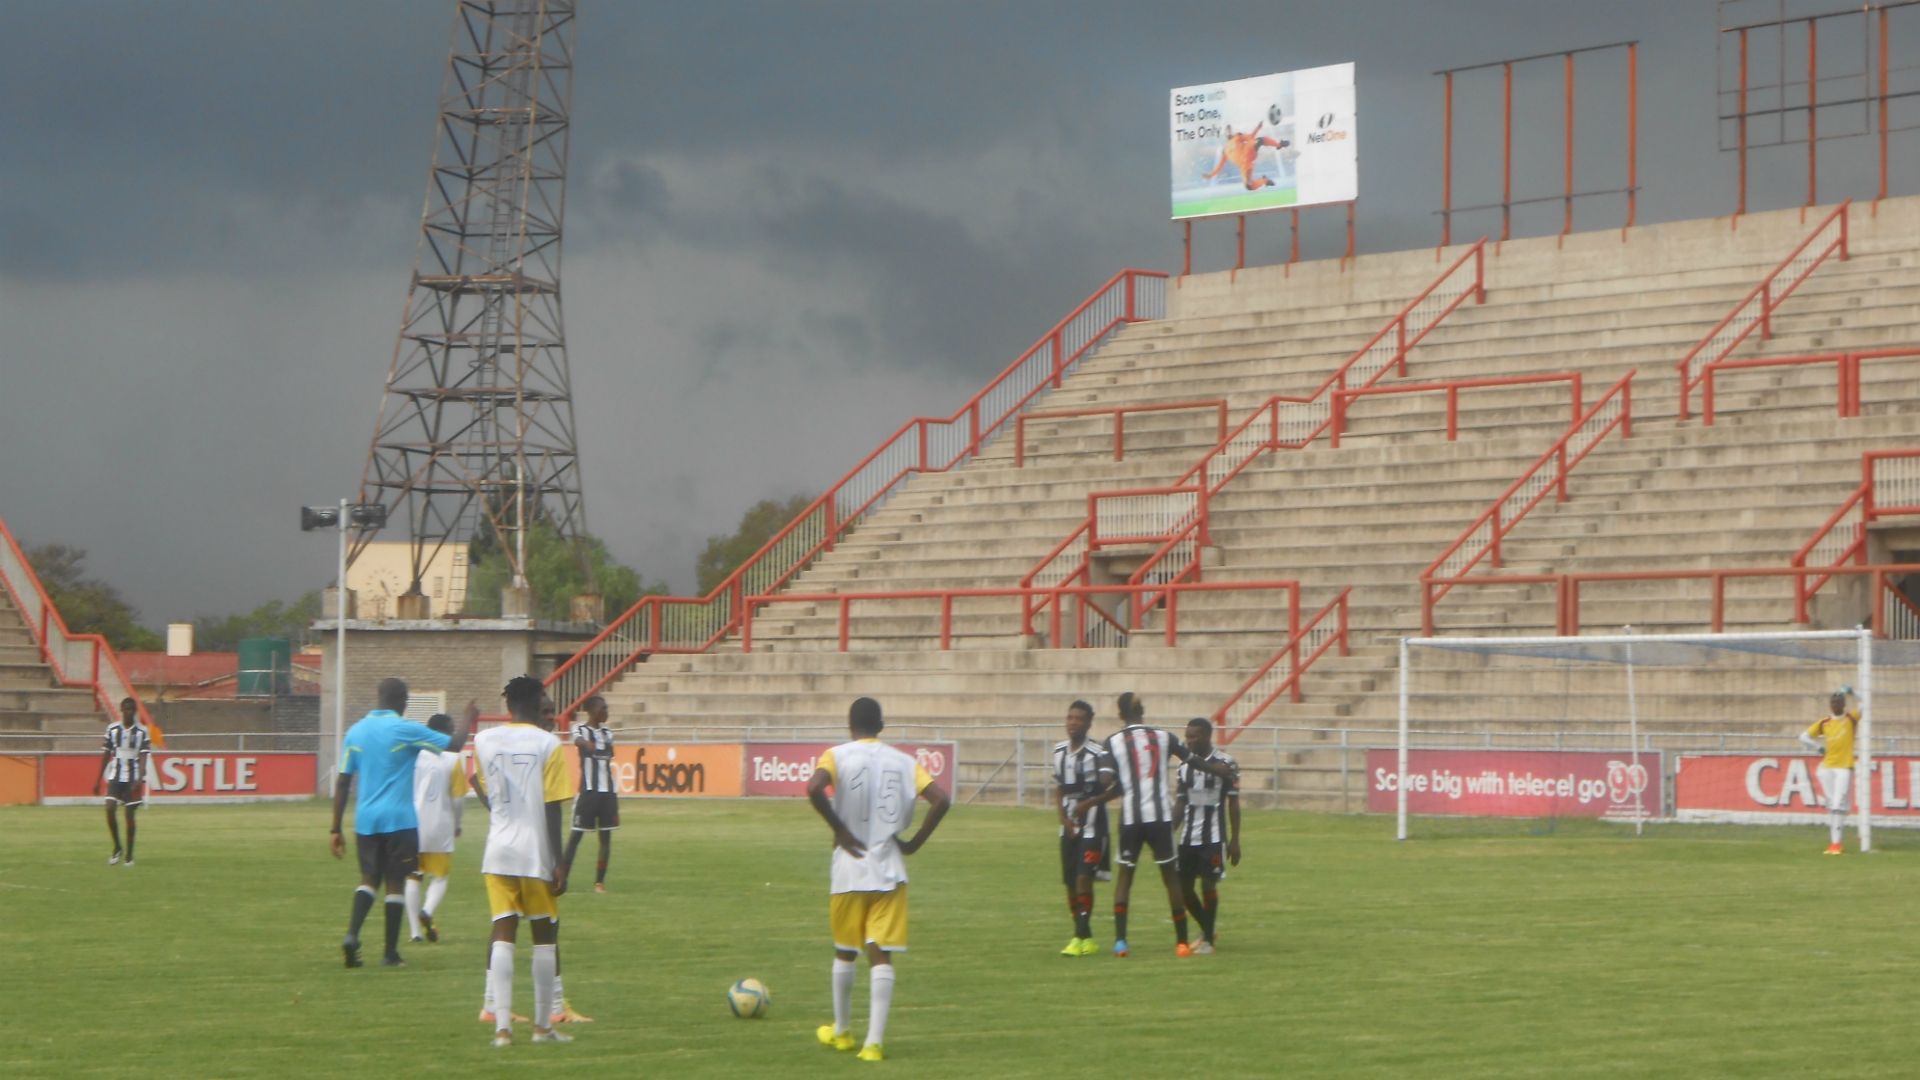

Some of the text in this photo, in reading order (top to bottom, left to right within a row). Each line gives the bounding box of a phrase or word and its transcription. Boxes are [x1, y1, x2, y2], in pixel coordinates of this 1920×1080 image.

[1175, 94, 1205, 106] Score
[1175, 111, 1195, 124] The
[1175, 124, 1222, 141] The Only
[1307, 130, 1347, 144] NetOne
[753, 756, 816, 782] Telecel
[1131, 744, 1160, 779] 17
[850, 767, 902, 824] 15
[1375, 767, 1606, 804] Scre big with telecel go
